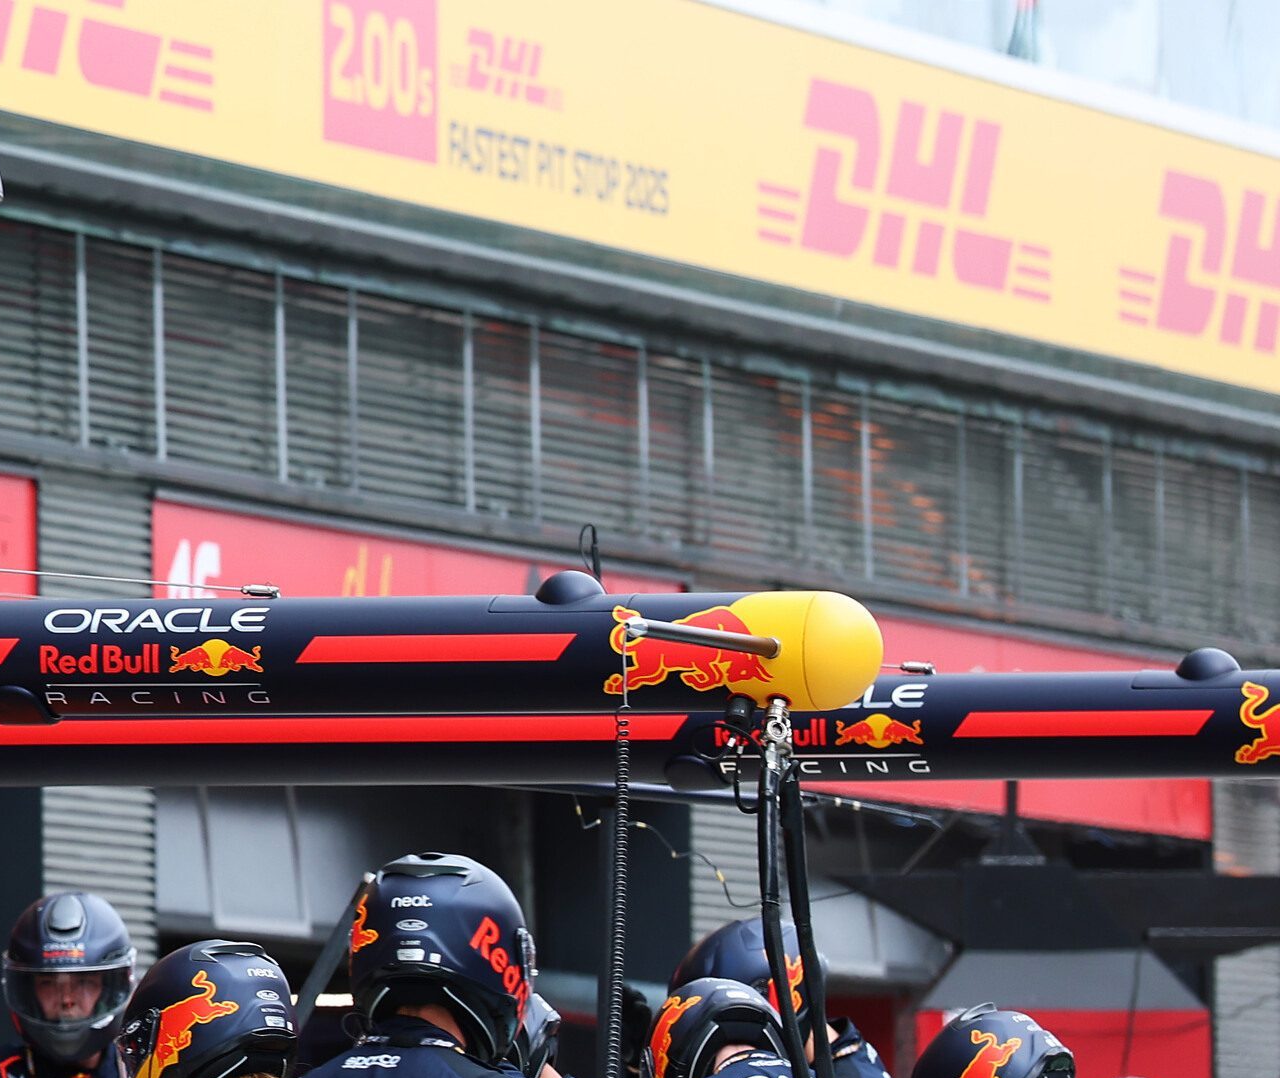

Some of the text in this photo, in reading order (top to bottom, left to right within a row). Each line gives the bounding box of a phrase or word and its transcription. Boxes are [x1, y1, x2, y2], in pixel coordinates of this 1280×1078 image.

[466, 26, 549, 106] DHL
[448, 118, 670, 216] FASTEST PIT STOP 2025
[792, 76, 1020, 293] DHL
[1154, 168, 1280, 356] DH
[43, 606, 270, 634] ORACLE
[39, 643, 160, 675] Red Bull
[44, 690, 271, 705] RACING
[793, 717, 827, 747] ull
[341, 1054, 402, 1069] sparco
